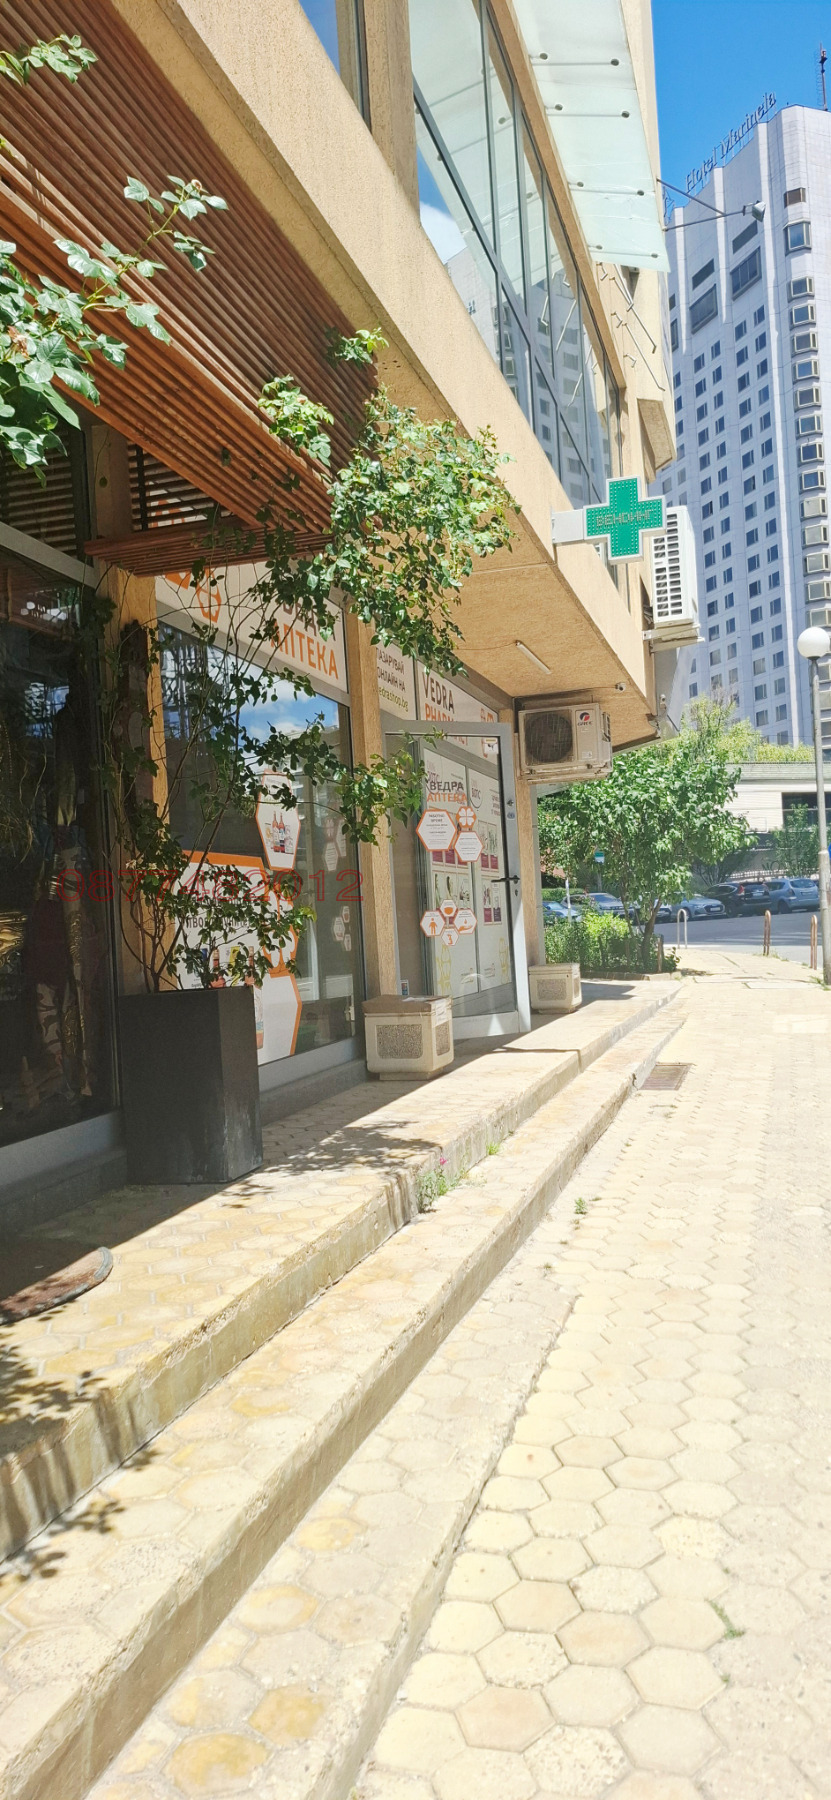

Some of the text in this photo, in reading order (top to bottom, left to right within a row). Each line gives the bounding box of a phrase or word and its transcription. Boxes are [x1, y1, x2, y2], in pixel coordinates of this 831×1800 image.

[686, 146, 718, 193] Hotel
[422, 671, 455, 714] VEDRA
[430, 781, 464, 792] ВЕДРА
